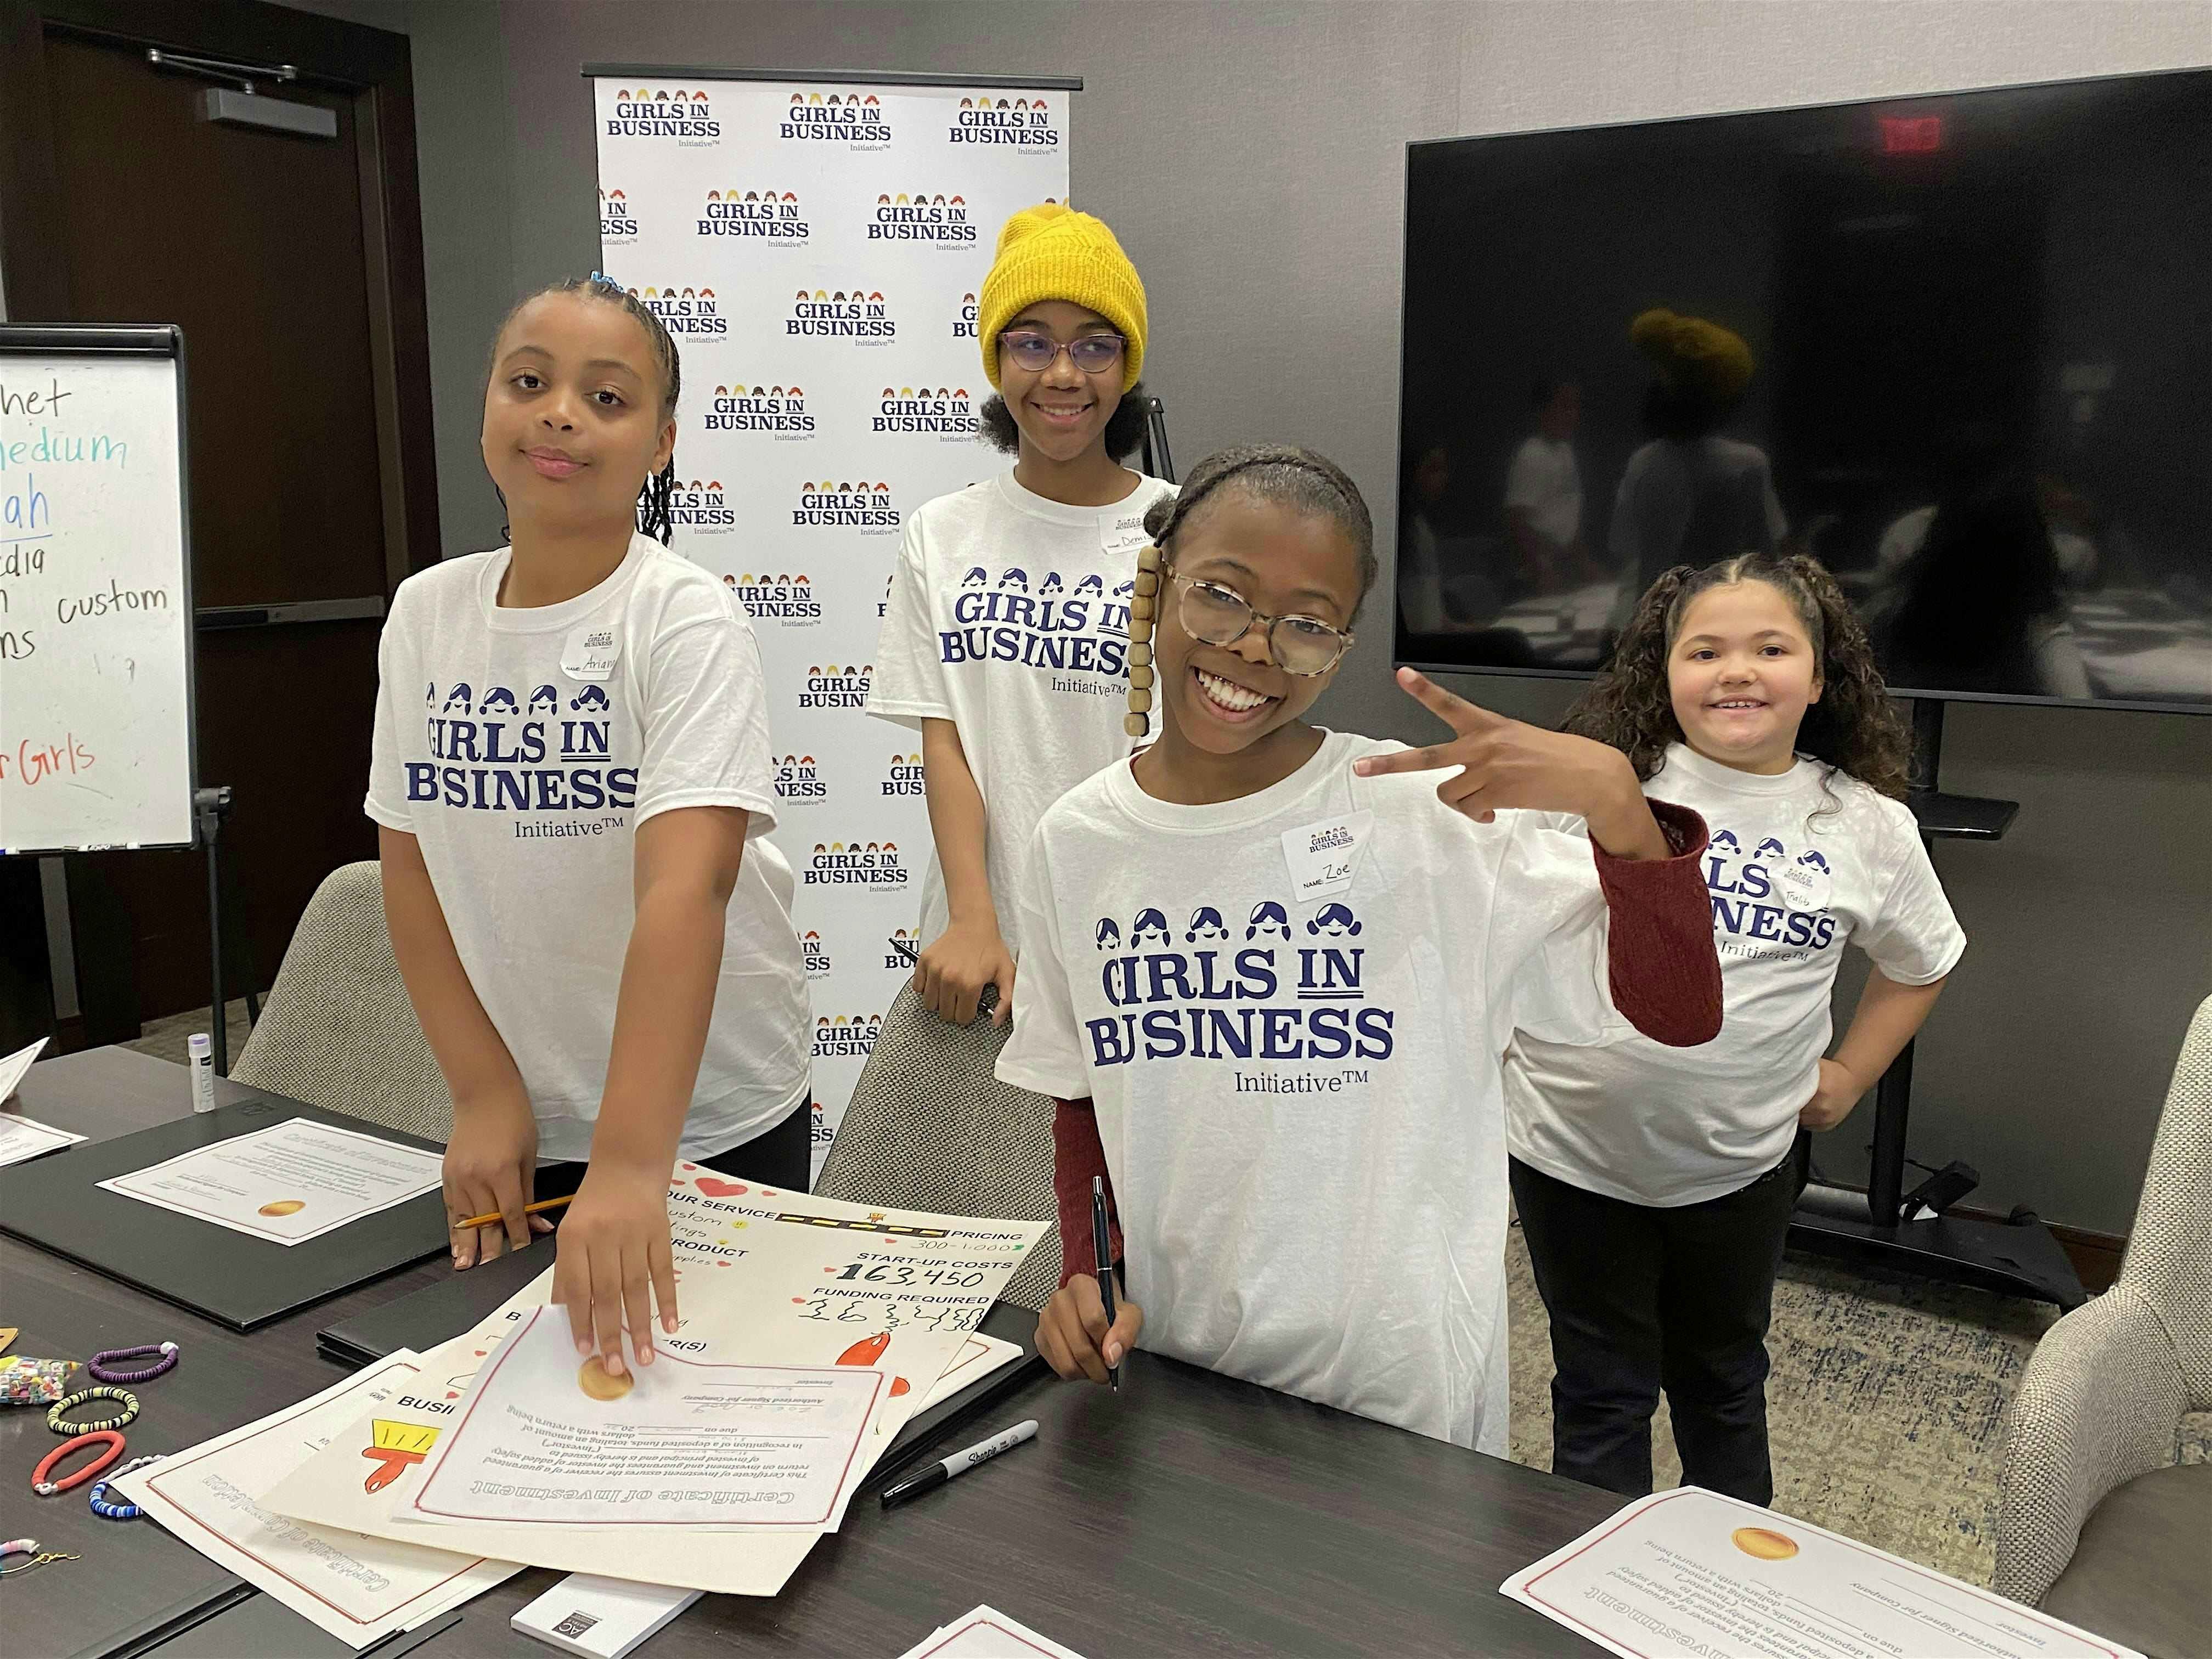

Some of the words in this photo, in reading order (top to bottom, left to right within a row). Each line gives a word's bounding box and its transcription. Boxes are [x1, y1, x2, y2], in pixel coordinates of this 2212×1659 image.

[616, 104, 684, 119] GIRLS
[690, 104, 709, 116] IN
[790, 106, 856, 123] GIRLS
[861, 109, 881, 120] IN
[959, 111, 1024, 127] GIRLS
[1030, 113, 1048, 125] IN
[607, 120, 720, 137] BUSINESS
[780, 123, 891, 140] BUSINESS
[949, 128, 1058, 145] BUSINESS
[607, 202, 627, 215] IN
[707, 204, 773, 219] GIRLS
[780, 205, 798, 217] IN
[877, 207, 942, 223] GIRLS
[947, 208, 966, 221] IN
[697, 221, 809, 237] BUSINESS
[867, 224, 976, 241] BUSINESS
[697, 301, 716, 313] IN
[795, 303, 860, 319] GIRLS
[867, 304, 885, 317] IN
[661, 318, 727, 333] INESS
[786, 320, 895, 336] BUSINESS
[0, 378, 72, 417] het
[714, 398, 780, 414] GIRLS
[786, 399, 804, 412] IN
[881, 401, 945, 416] GIRLS
[952, 402, 969, 413] IN
[704, 415, 815, 431] BUSINESS
[872, 417, 979, 432] BUSINESS
[0, 426, 127, 471] edium
[705, 494, 724, 505] IN
[802, 494, 866, 509] GIRLS
[872, 495, 890, 506] IN
[669, 510, 735, 524] INESS
[793, 511, 900, 525] BUSINESS
[735, 586, 787, 601] IRLS
[793, 588, 811, 599] IN
[744, 603, 821, 617] SINESS
[955, 592, 1089, 631] GIRLS
[939, 627, 1130, 679] BUSINES
[808, 678, 870, 692] GIRLS
[799, 693, 866, 708] BUSIN
[561, 721, 610, 754] IN
[798, 768, 816, 779] IN
[891, 766, 923, 780] GIR
[404, 763, 639, 811] BSINESS
[774, 783, 826, 796] NESS
[1309, 836, 1354, 853] BUSINESS
[1311, 833, 1339, 845] GIRLS
[813, 855, 875, 868] GIRLS
[881, 855, 898, 865] IN
[804, 869, 908, 884] BUSINESS
[1323, 864, 1350, 879] Zoe
[1711, 896, 1836, 950] NESS
[804, 942, 820, 954] IN
[1297, 949, 1364, 988] IN
[816, 1026, 878, 1042] GIRLS
[811, 1042, 876, 1057] BUSIN
[812, 1114, 823, 1125] N
[702, 1200, 777, 1219] SERVICE
[669, 1210, 722, 1226] ustom
[951, 1230, 1023, 1240] PRICING
[672, 1238, 749, 1257] RODUCT
[857, 1252, 948, 1267] START-UP
[951, 1261, 1013, 1269] COSTS
[836, 1263, 984, 1288] 163,450
[813, 1288, 892, 1301] FUNDING
[896, 1294, 989, 1304] REQUIRED
[470, 1481, 622, 1503] Investment
[620, 1490, 652, 1503] of
[658, 1491, 794, 1504] Certificate
[559, 1623, 583, 1635] AC
[1584, 1587, 1731, 1659] nvestment
